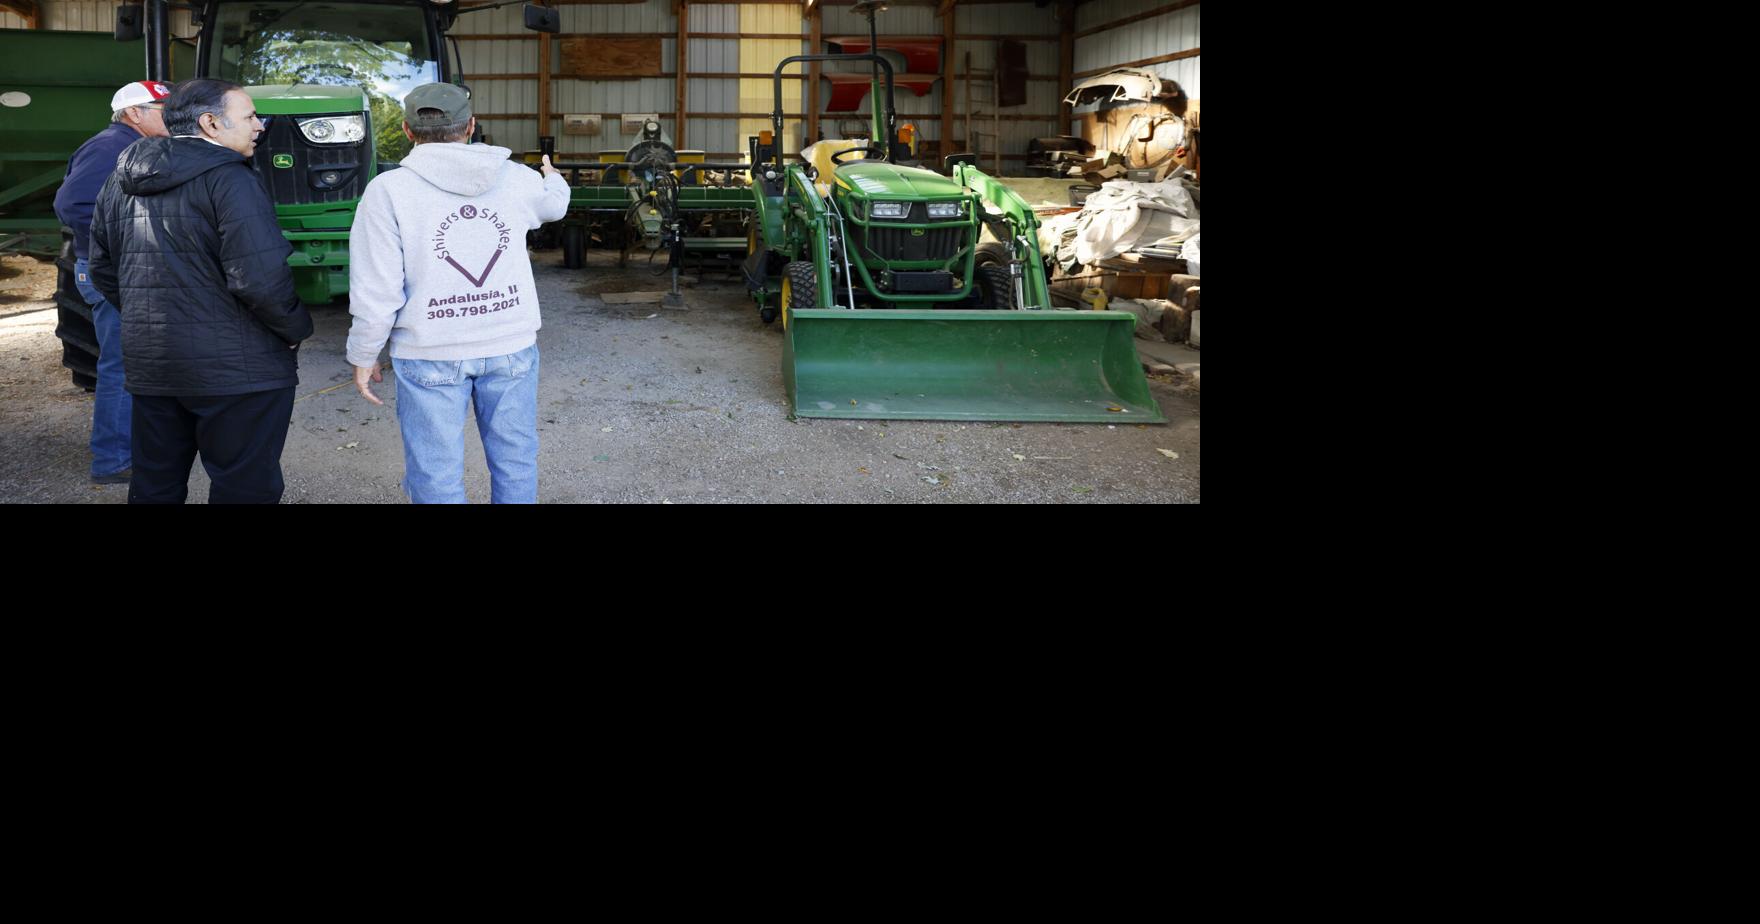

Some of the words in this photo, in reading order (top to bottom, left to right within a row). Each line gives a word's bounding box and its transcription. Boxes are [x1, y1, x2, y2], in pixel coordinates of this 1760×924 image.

[432, 212, 459, 260] Shivers
[461, 205, 476, 218] &
[479, 208, 511, 250] Shakes
[427, 296, 520, 320] 309.798.2021
[428, 290, 505, 308] Andalusia,
